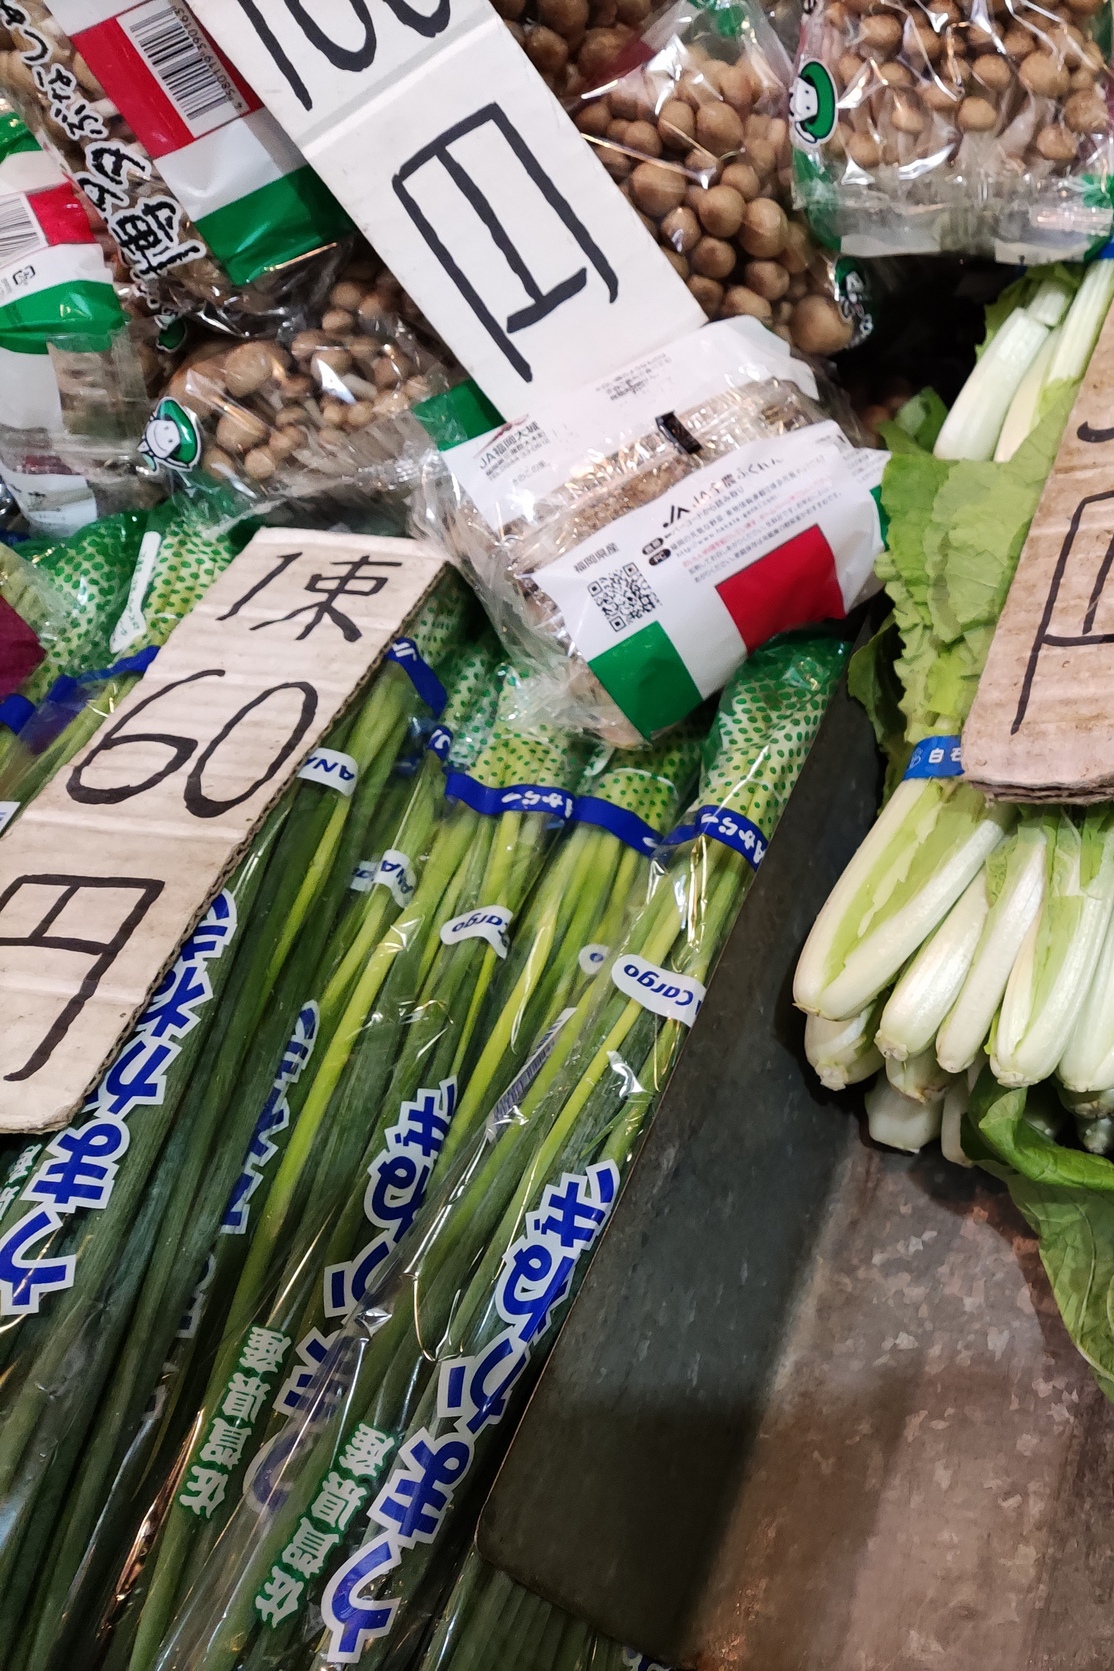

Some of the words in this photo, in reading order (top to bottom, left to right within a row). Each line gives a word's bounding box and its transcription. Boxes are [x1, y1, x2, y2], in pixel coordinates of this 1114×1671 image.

[393, 101, 620, 383] 円
[216, 552, 402, 642] 1束
[573, 542, 618, 572] 福岡県産
[66, 669, 319, 818] 60
[0, 874, 165, 1081] 円
[622, 964, 692, 1004] Cargo
[183, 1322, 292, 1517] 佐賀県産
[332, 1164, 616, 1652] うまかねぎ
[262, 1421, 394, 1626] 佐賀県産
